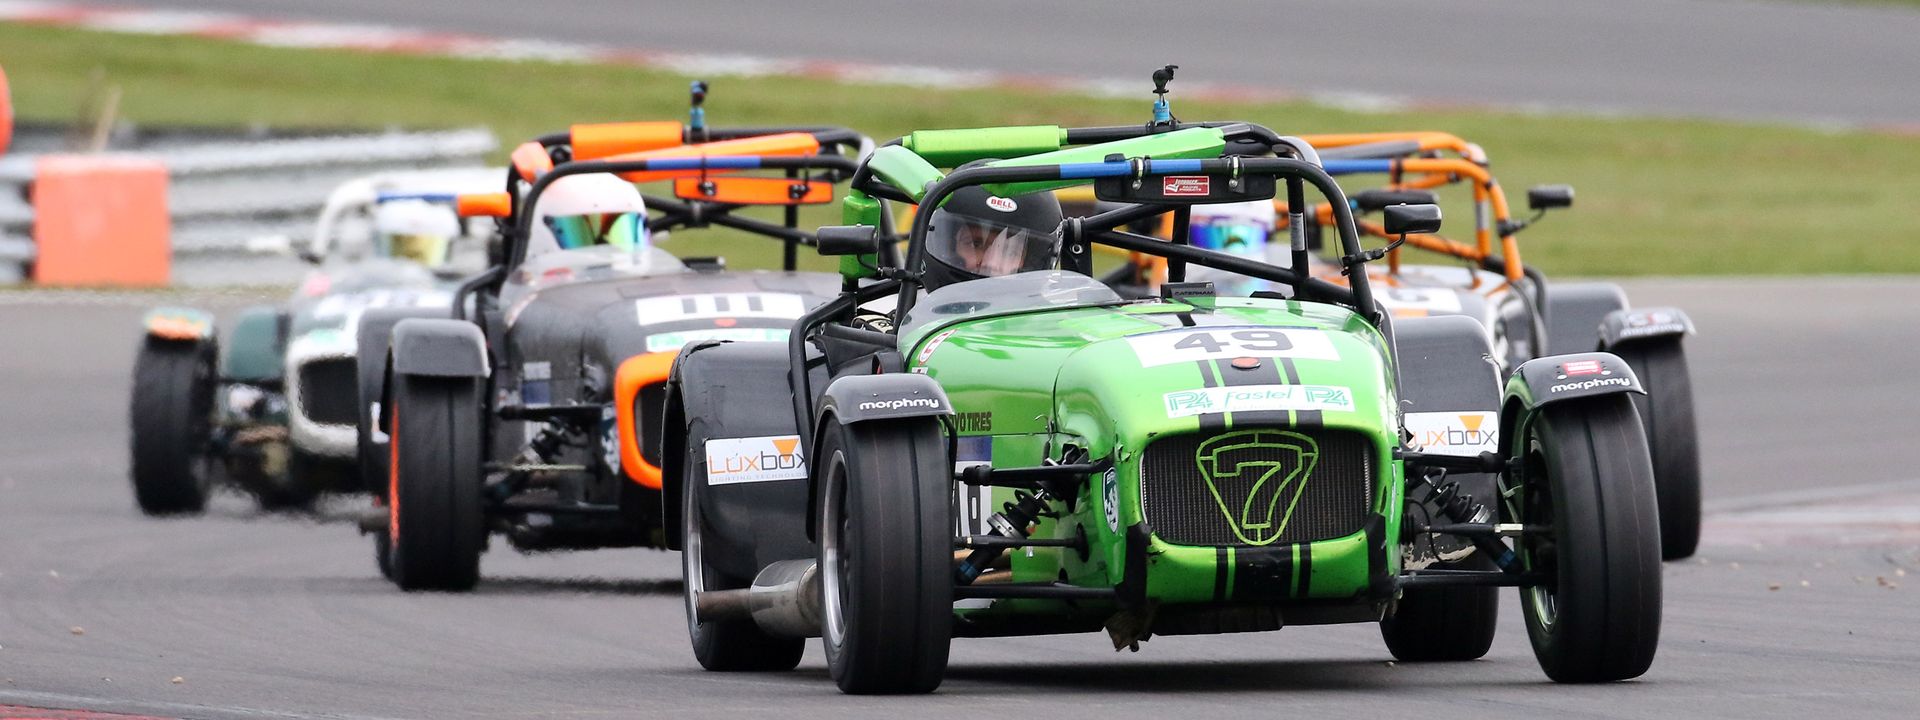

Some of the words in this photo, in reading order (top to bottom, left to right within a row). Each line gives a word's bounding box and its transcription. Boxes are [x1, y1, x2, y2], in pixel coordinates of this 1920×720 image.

[991, 199, 1012, 209] BELL
[1173, 330, 1294, 353] 49
[1551, 377, 1631, 393] morphmy
[860, 398, 939, 410] morphmy
[1168, 391, 1214, 412] P4
[1304, 386, 1348, 406] P4
[944, 412, 966, 432] YO
[966, 411, 992, 432] TIRES
[1408, 426, 1497, 447] uxbox
[1212, 442, 1303, 529] 7
